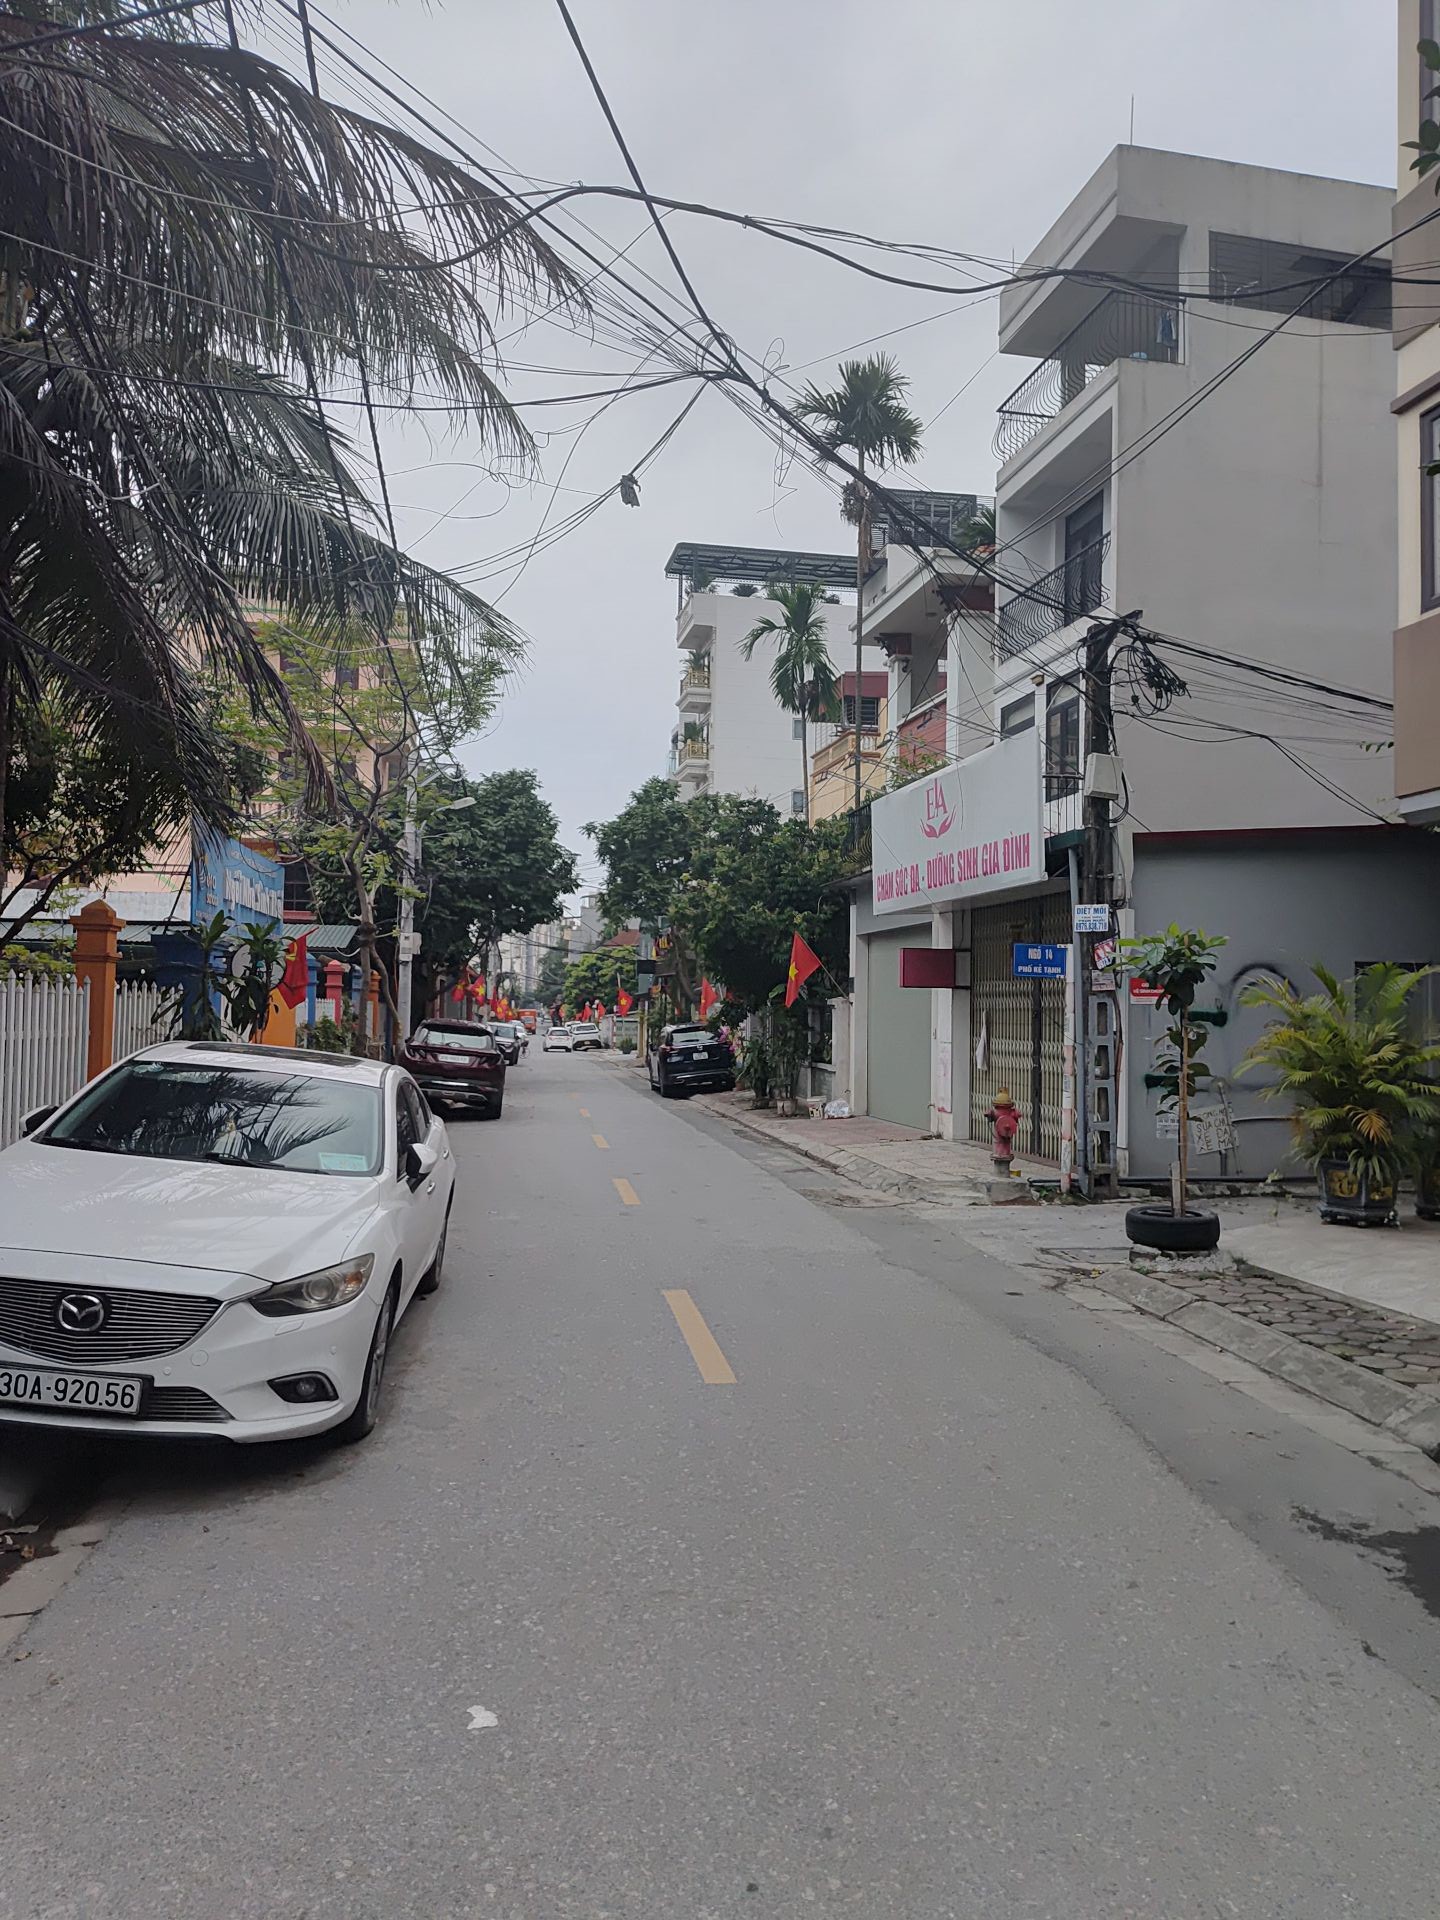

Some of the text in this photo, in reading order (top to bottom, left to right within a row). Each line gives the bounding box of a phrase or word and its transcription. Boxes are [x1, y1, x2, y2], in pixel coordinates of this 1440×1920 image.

[957, 846, 979, 882] SINH
[981, 840, 1000, 877] GIA
[1002, 831, 1030, 872] ĐÌNH
[1028, 946, 1042, 960] NGÕ
[1018, 963, 1032, 973] PHỐ
[0, 1371, 136, 1409] 30A-920.56
